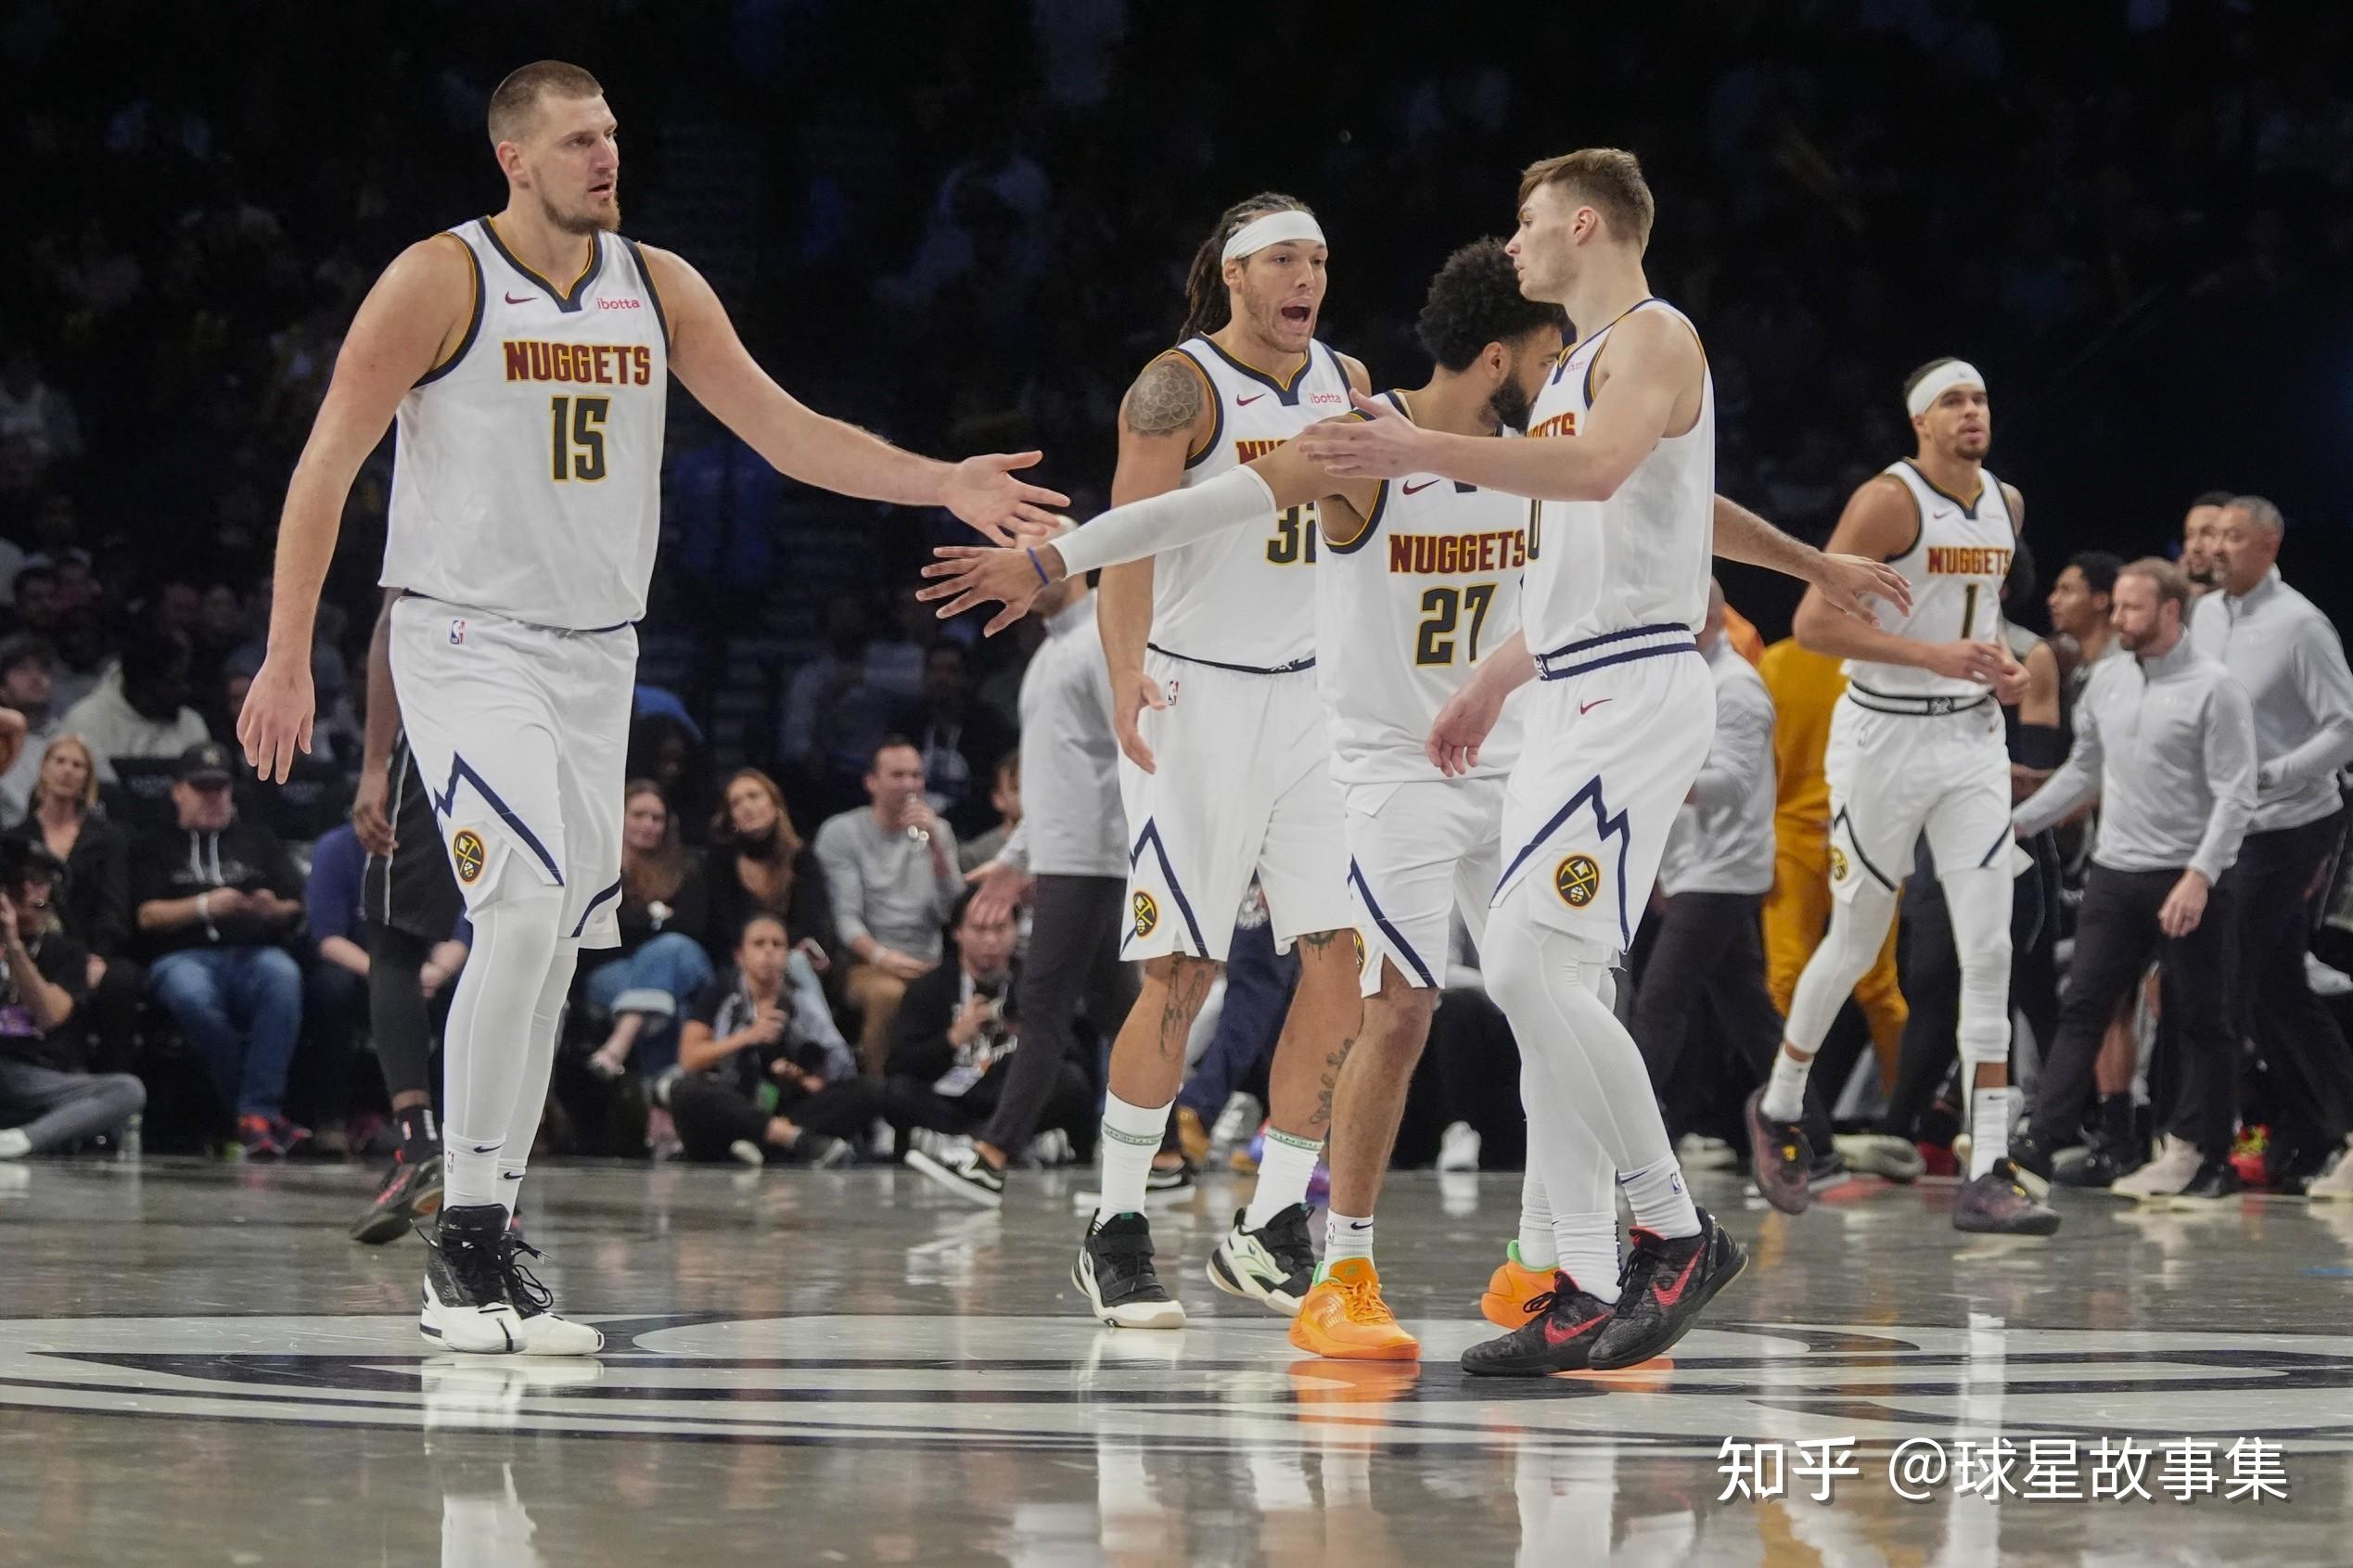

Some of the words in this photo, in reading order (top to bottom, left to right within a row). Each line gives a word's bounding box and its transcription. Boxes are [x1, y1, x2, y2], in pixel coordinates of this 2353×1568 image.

[596, 297, 640, 310] ibotta
[503, 341, 651, 386] NUGGETS
[1309, 392, 1342, 404] ibotta
[551, 394, 611, 483] 15
[1388, 527, 1526, 575] NUGGETS
[1414, 581, 1500, 669] 27
[1961, 582, 1979, 640] 1
